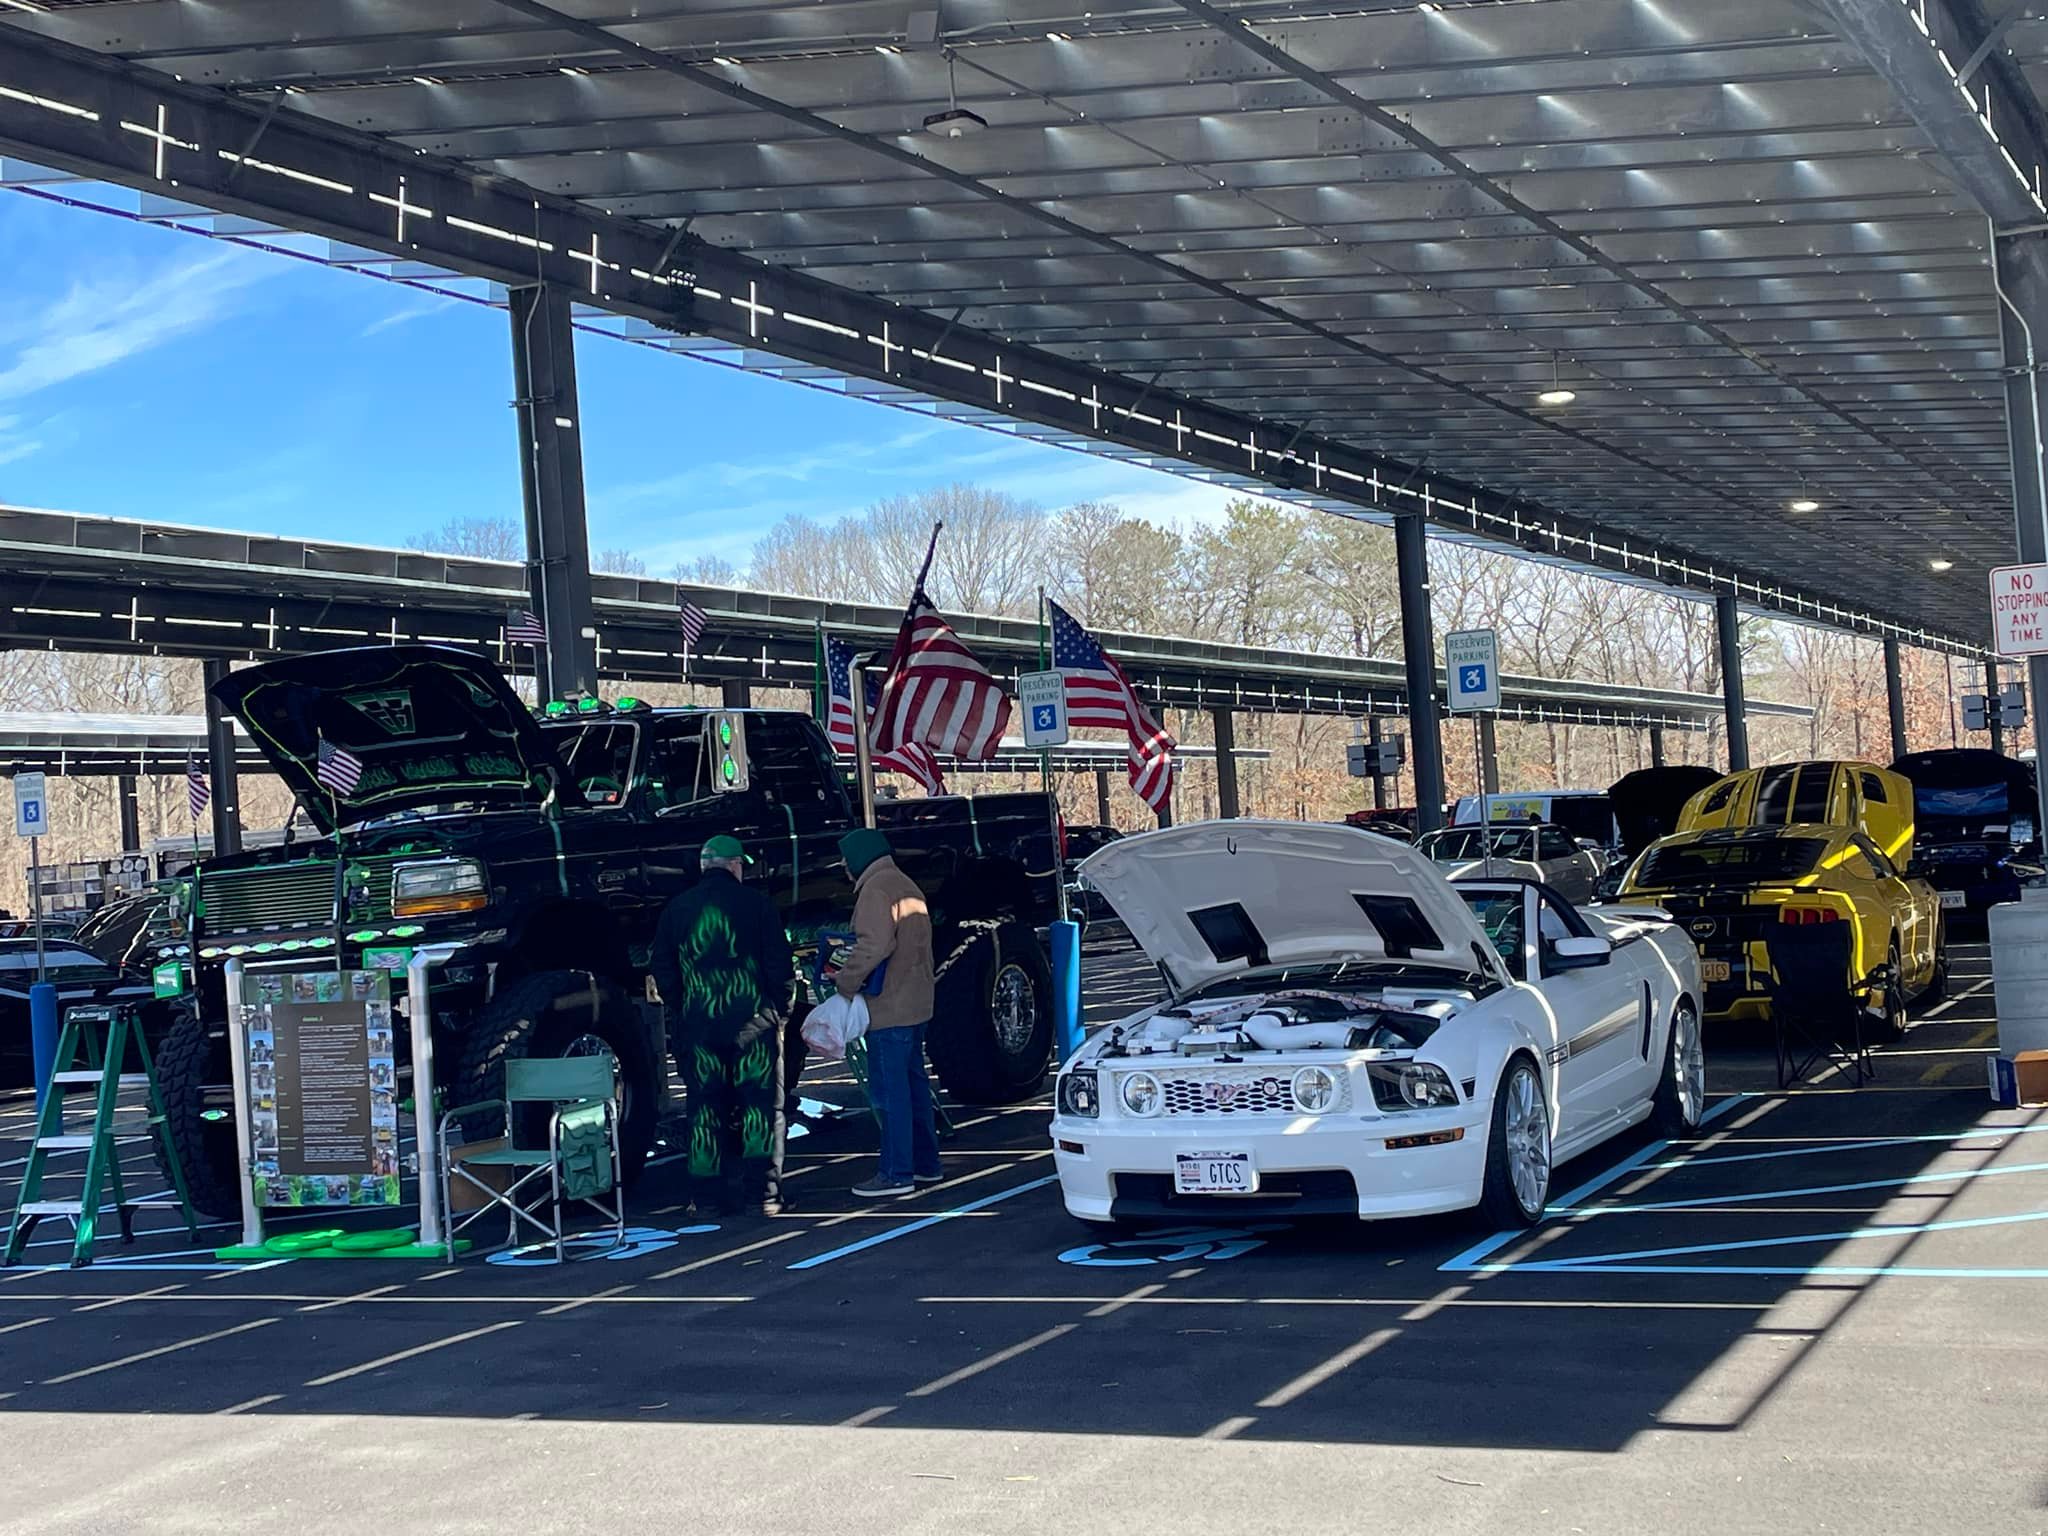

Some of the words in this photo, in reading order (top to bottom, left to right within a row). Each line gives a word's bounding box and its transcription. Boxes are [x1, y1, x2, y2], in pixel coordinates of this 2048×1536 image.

[2011, 573, 2033, 590] NO
[2012, 612, 2038, 625] ANY
[2010, 628, 2043, 642] TIME
[1449, 636, 1491, 649] RESERVED
[1453, 650, 1490, 663] PARKING
[1023, 678, 1060, 689] RESERVED
[1026, 691, 1059, 702] PARKING
[1209, 1163, 1241, 1184] GTCS
